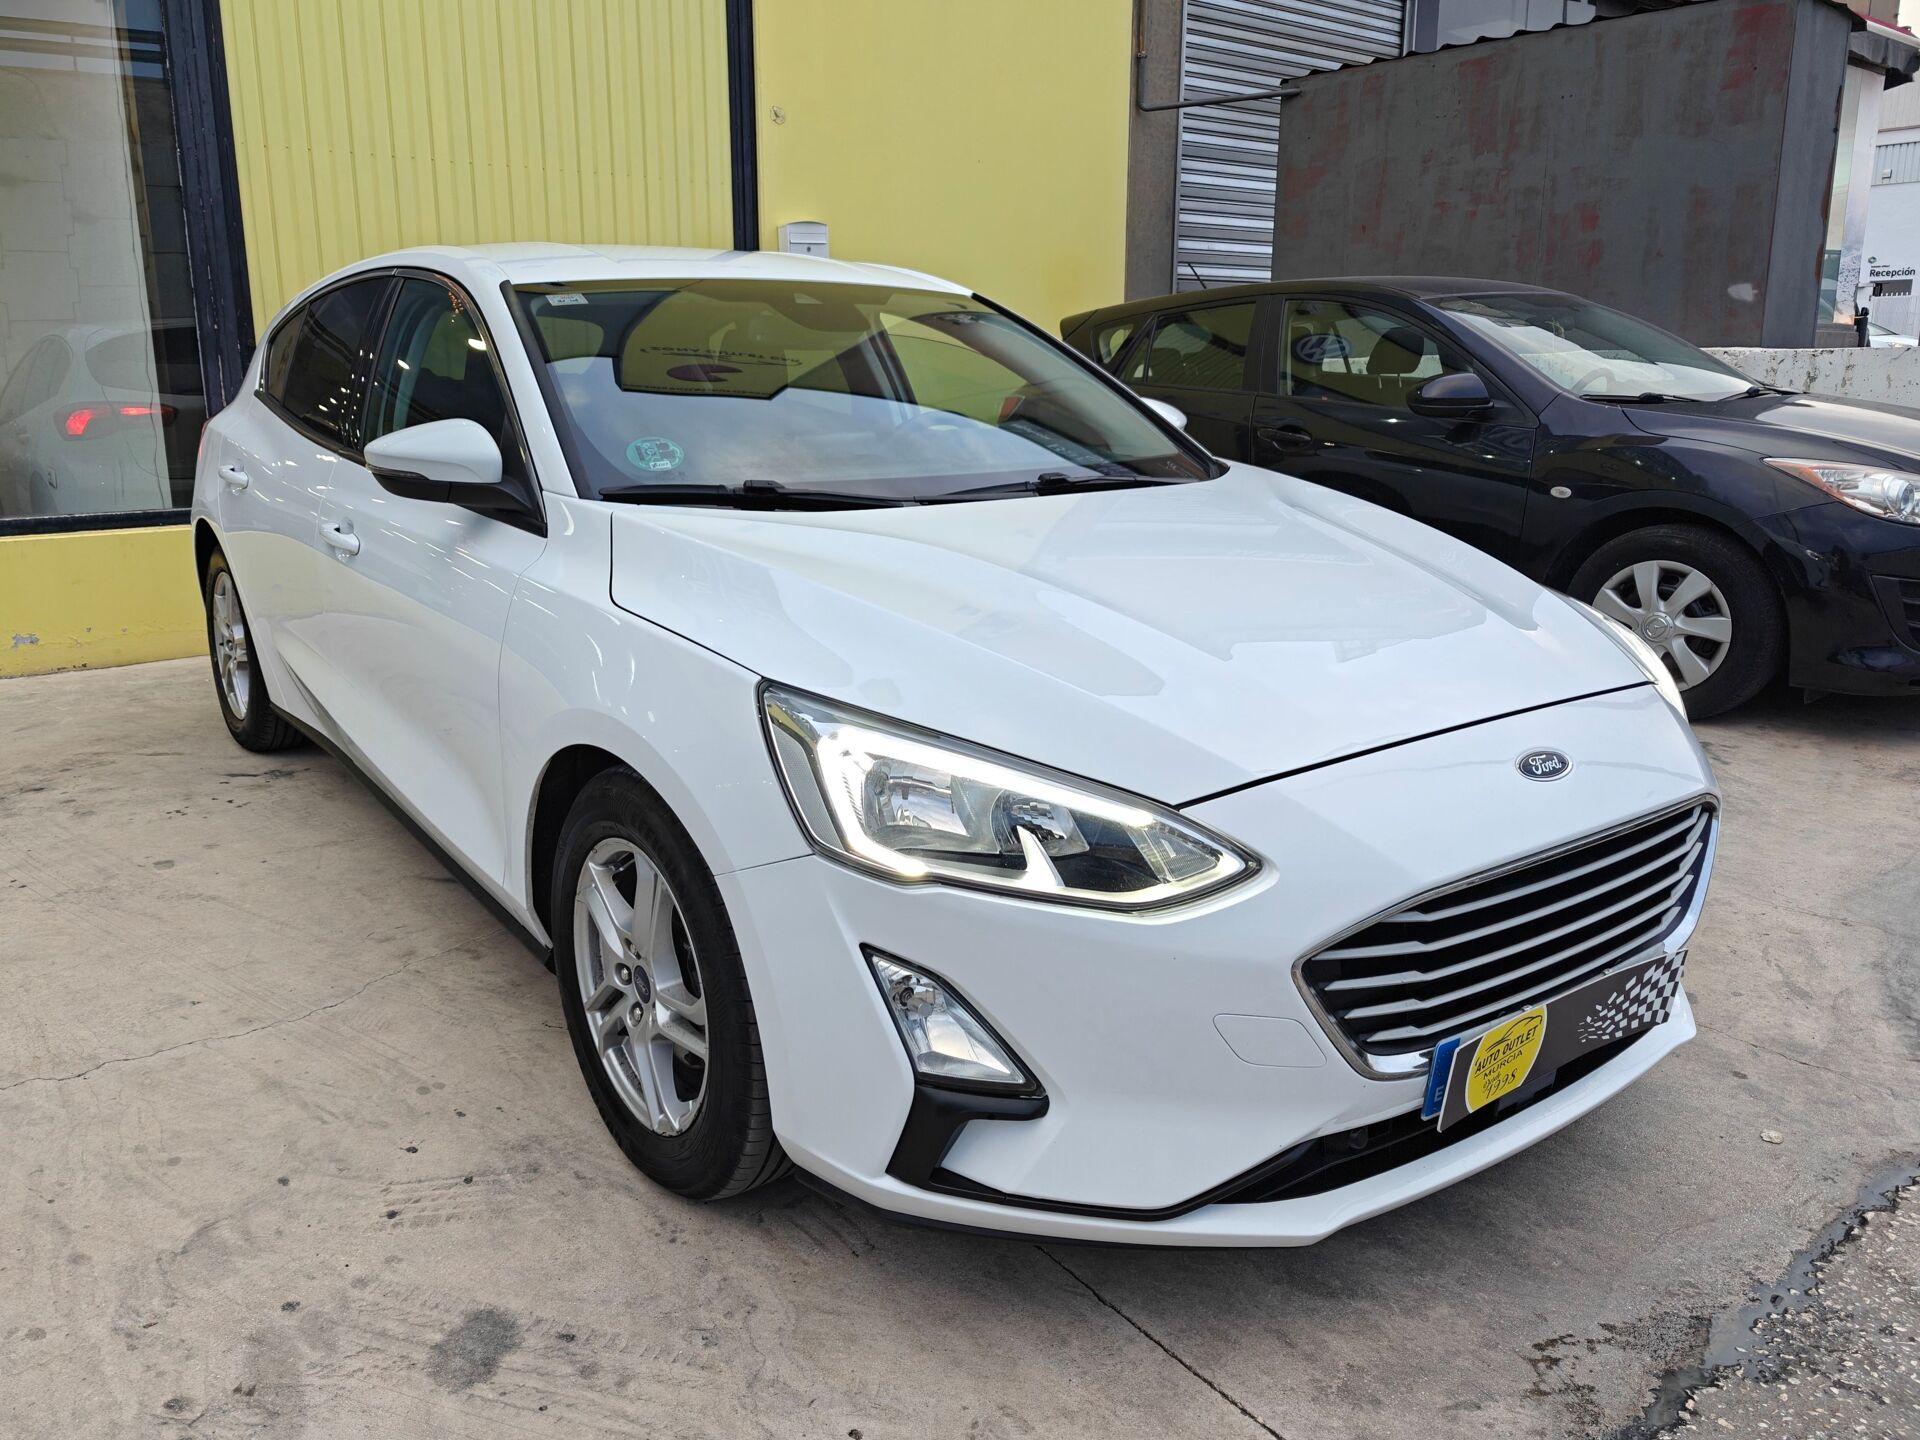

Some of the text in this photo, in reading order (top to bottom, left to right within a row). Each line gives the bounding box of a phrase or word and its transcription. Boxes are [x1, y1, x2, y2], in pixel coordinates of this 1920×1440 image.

[1869, 267, 1916, 278] Recepción
[1529, 754, 1562, 775] Ford
[1475, 1025, 1538, 1075] AUTO OUTLET
[1483, 1049, 1523, 1079] MURCIA
